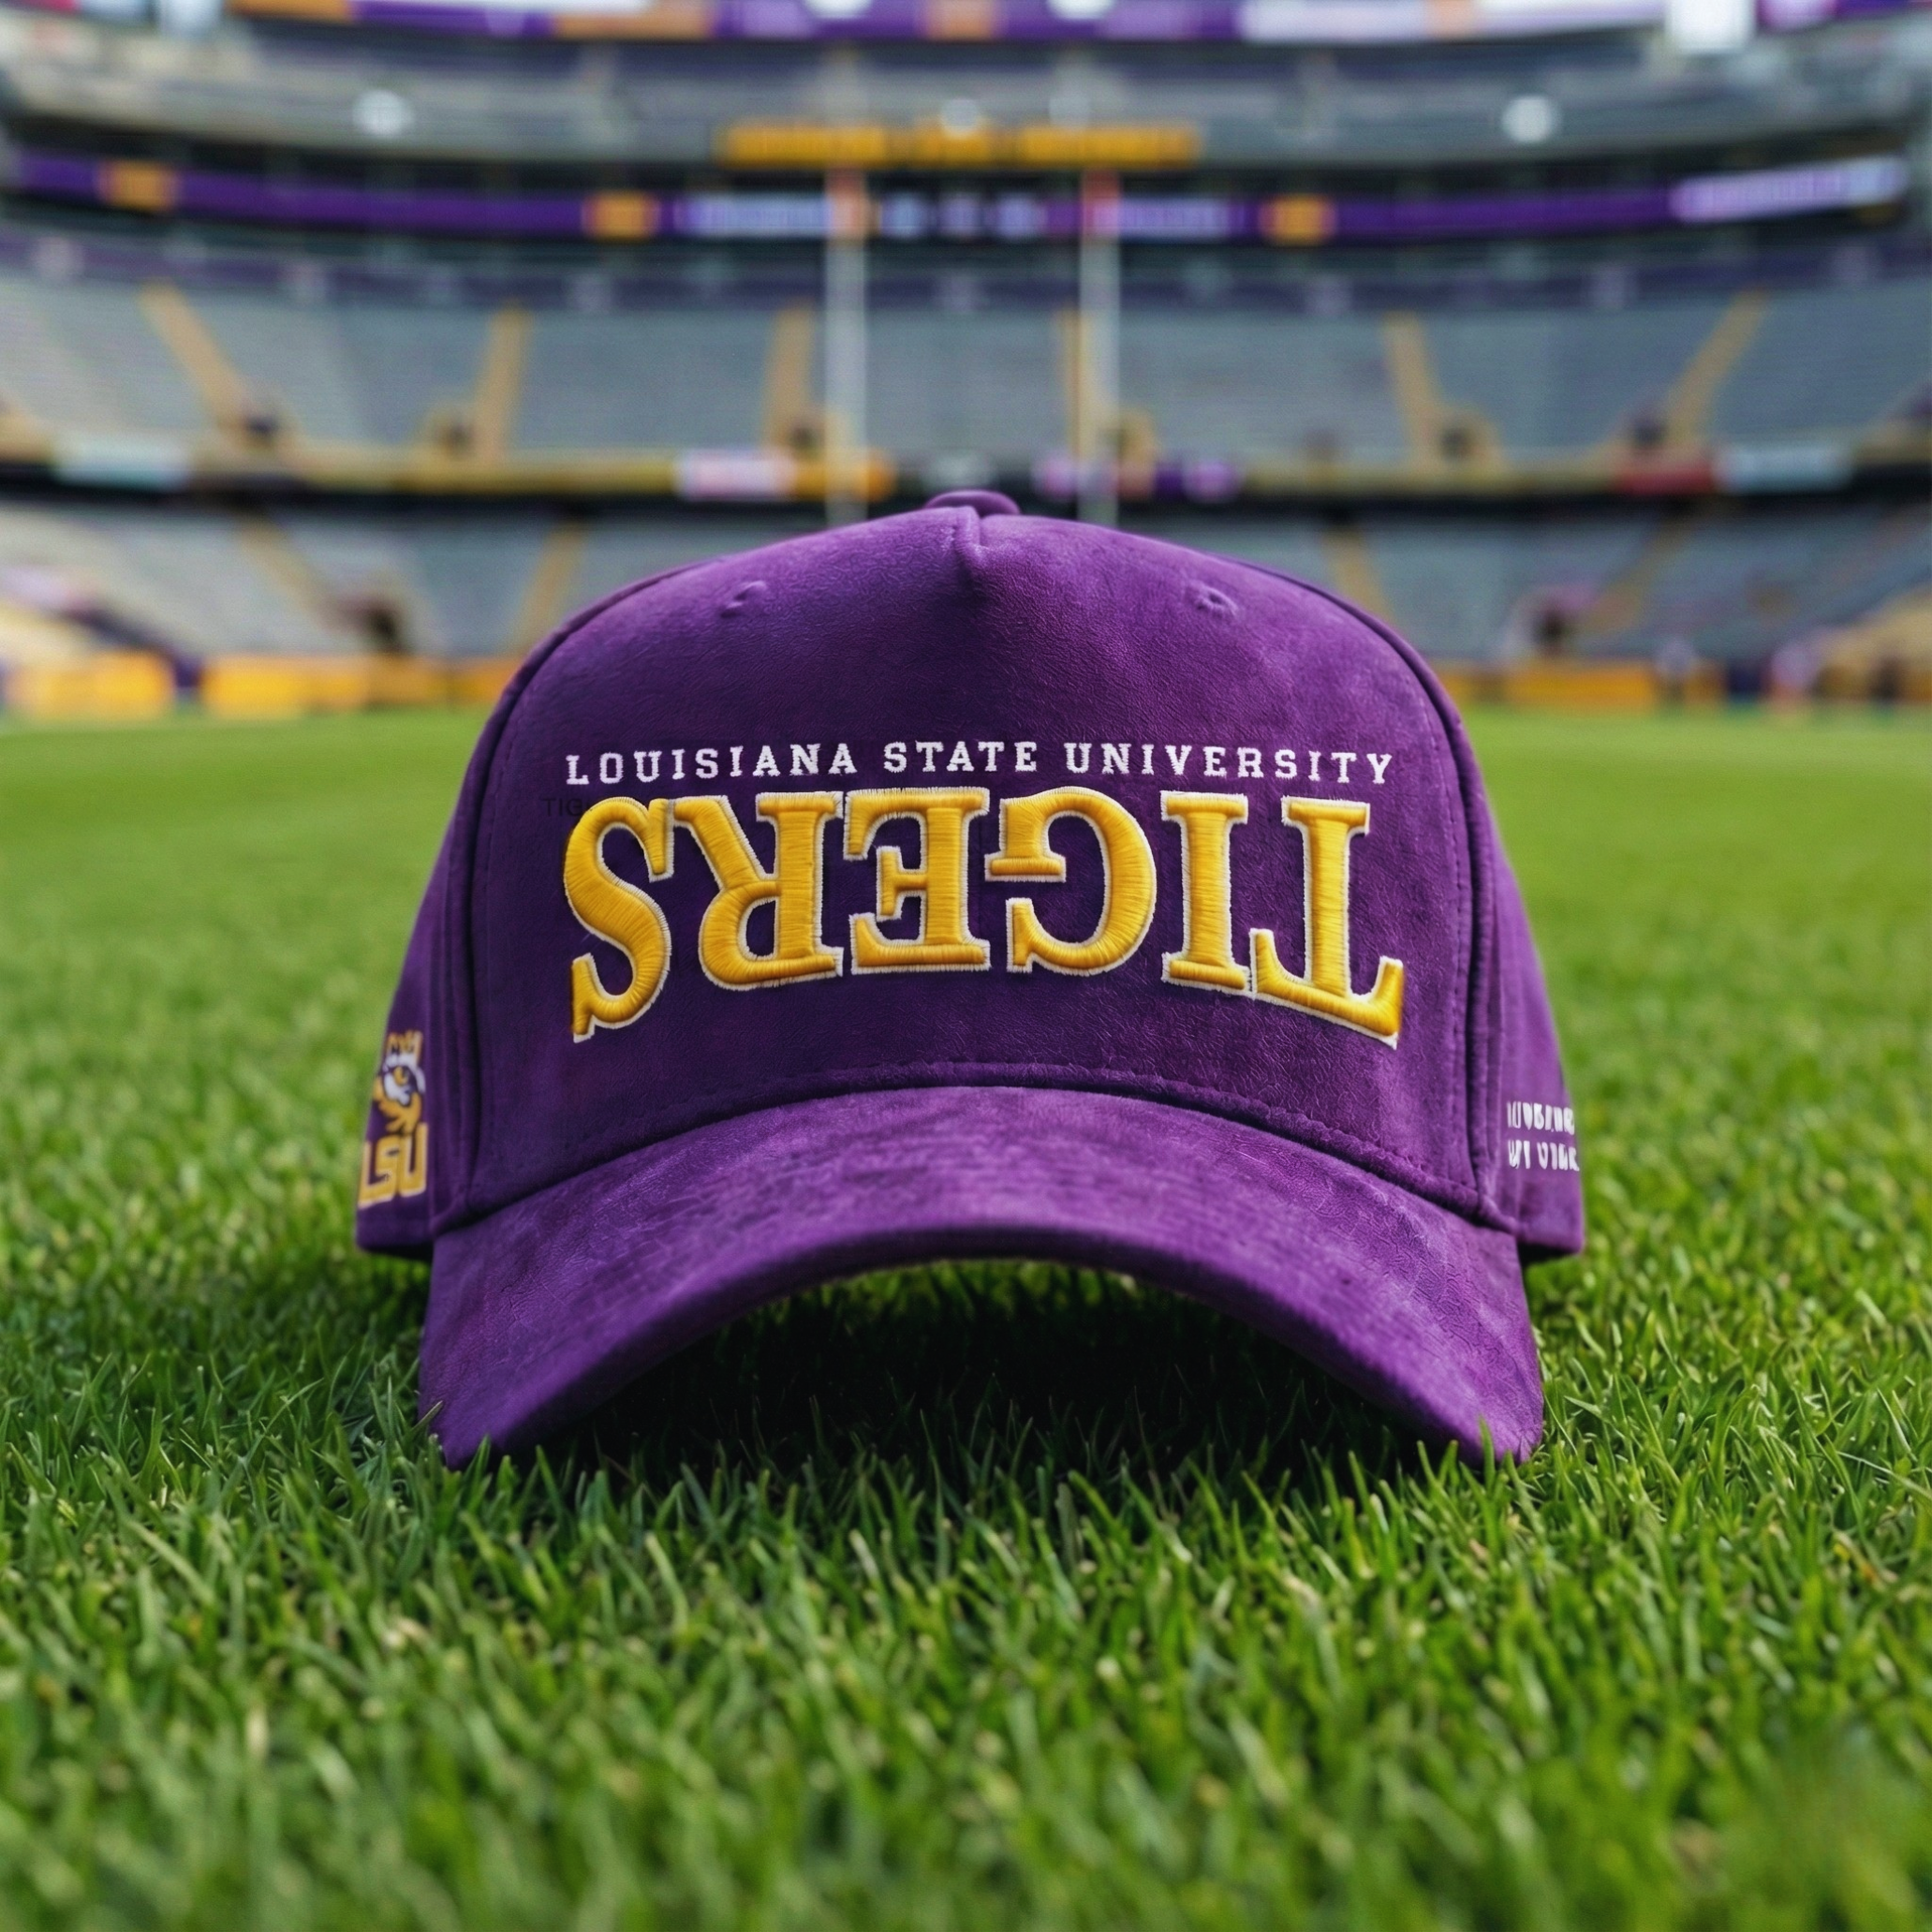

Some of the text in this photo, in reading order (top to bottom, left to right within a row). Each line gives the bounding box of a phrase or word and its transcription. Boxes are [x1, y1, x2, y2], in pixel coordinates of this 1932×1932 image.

[567, 741, 1392, 785] LOUISIANA STATE UNIVERSITY
[563, 786, 1404, 1049] TIGERS
[358, 1122, 429, 1208] LSU
